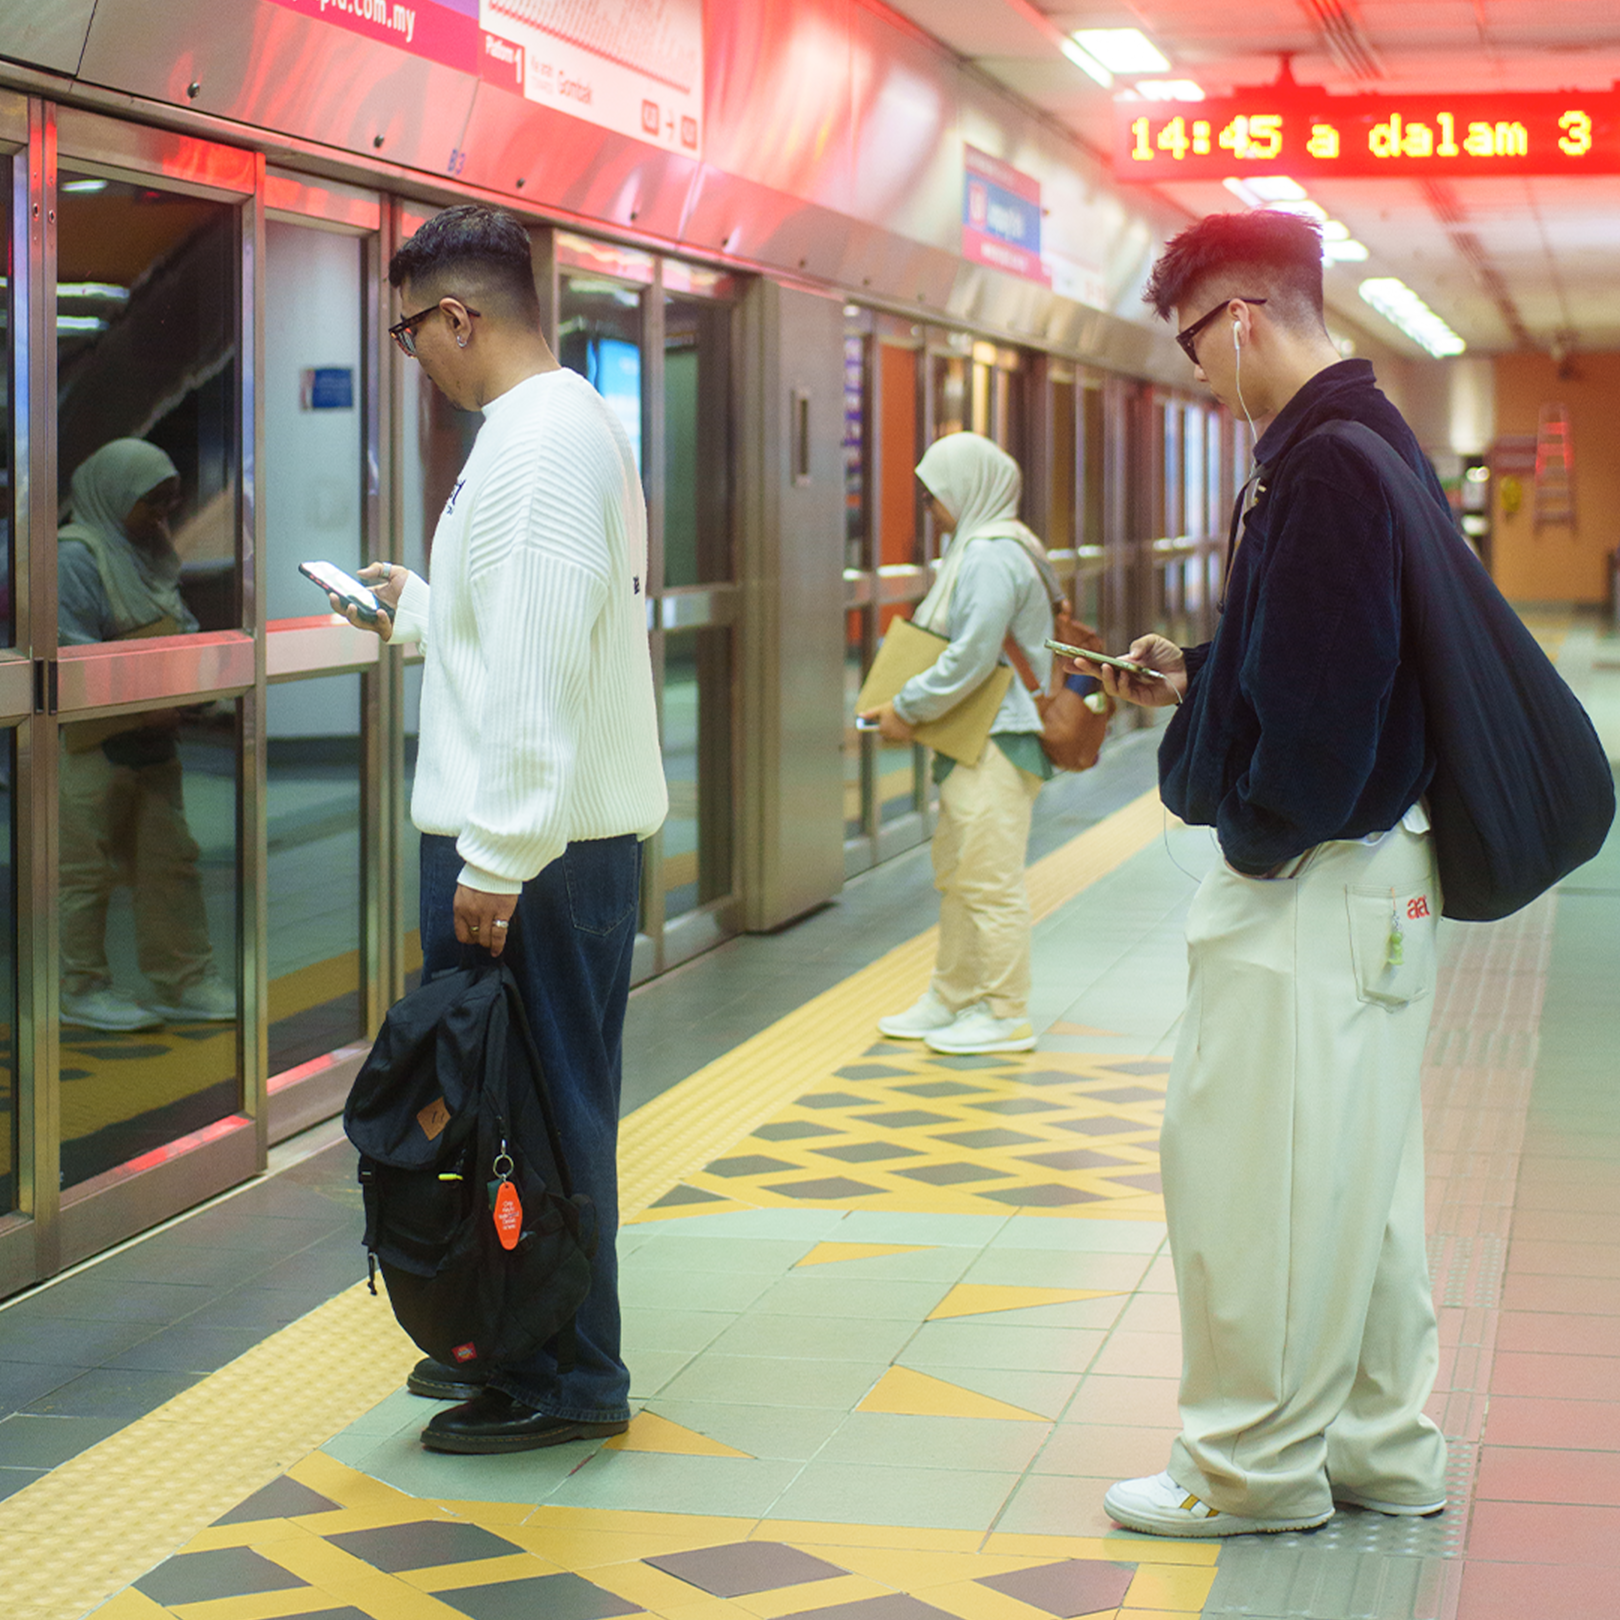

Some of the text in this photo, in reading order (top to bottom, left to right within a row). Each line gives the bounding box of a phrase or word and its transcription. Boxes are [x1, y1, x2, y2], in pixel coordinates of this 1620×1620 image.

[1131, 110, 1593, 161] 14:45 a dalam 3
